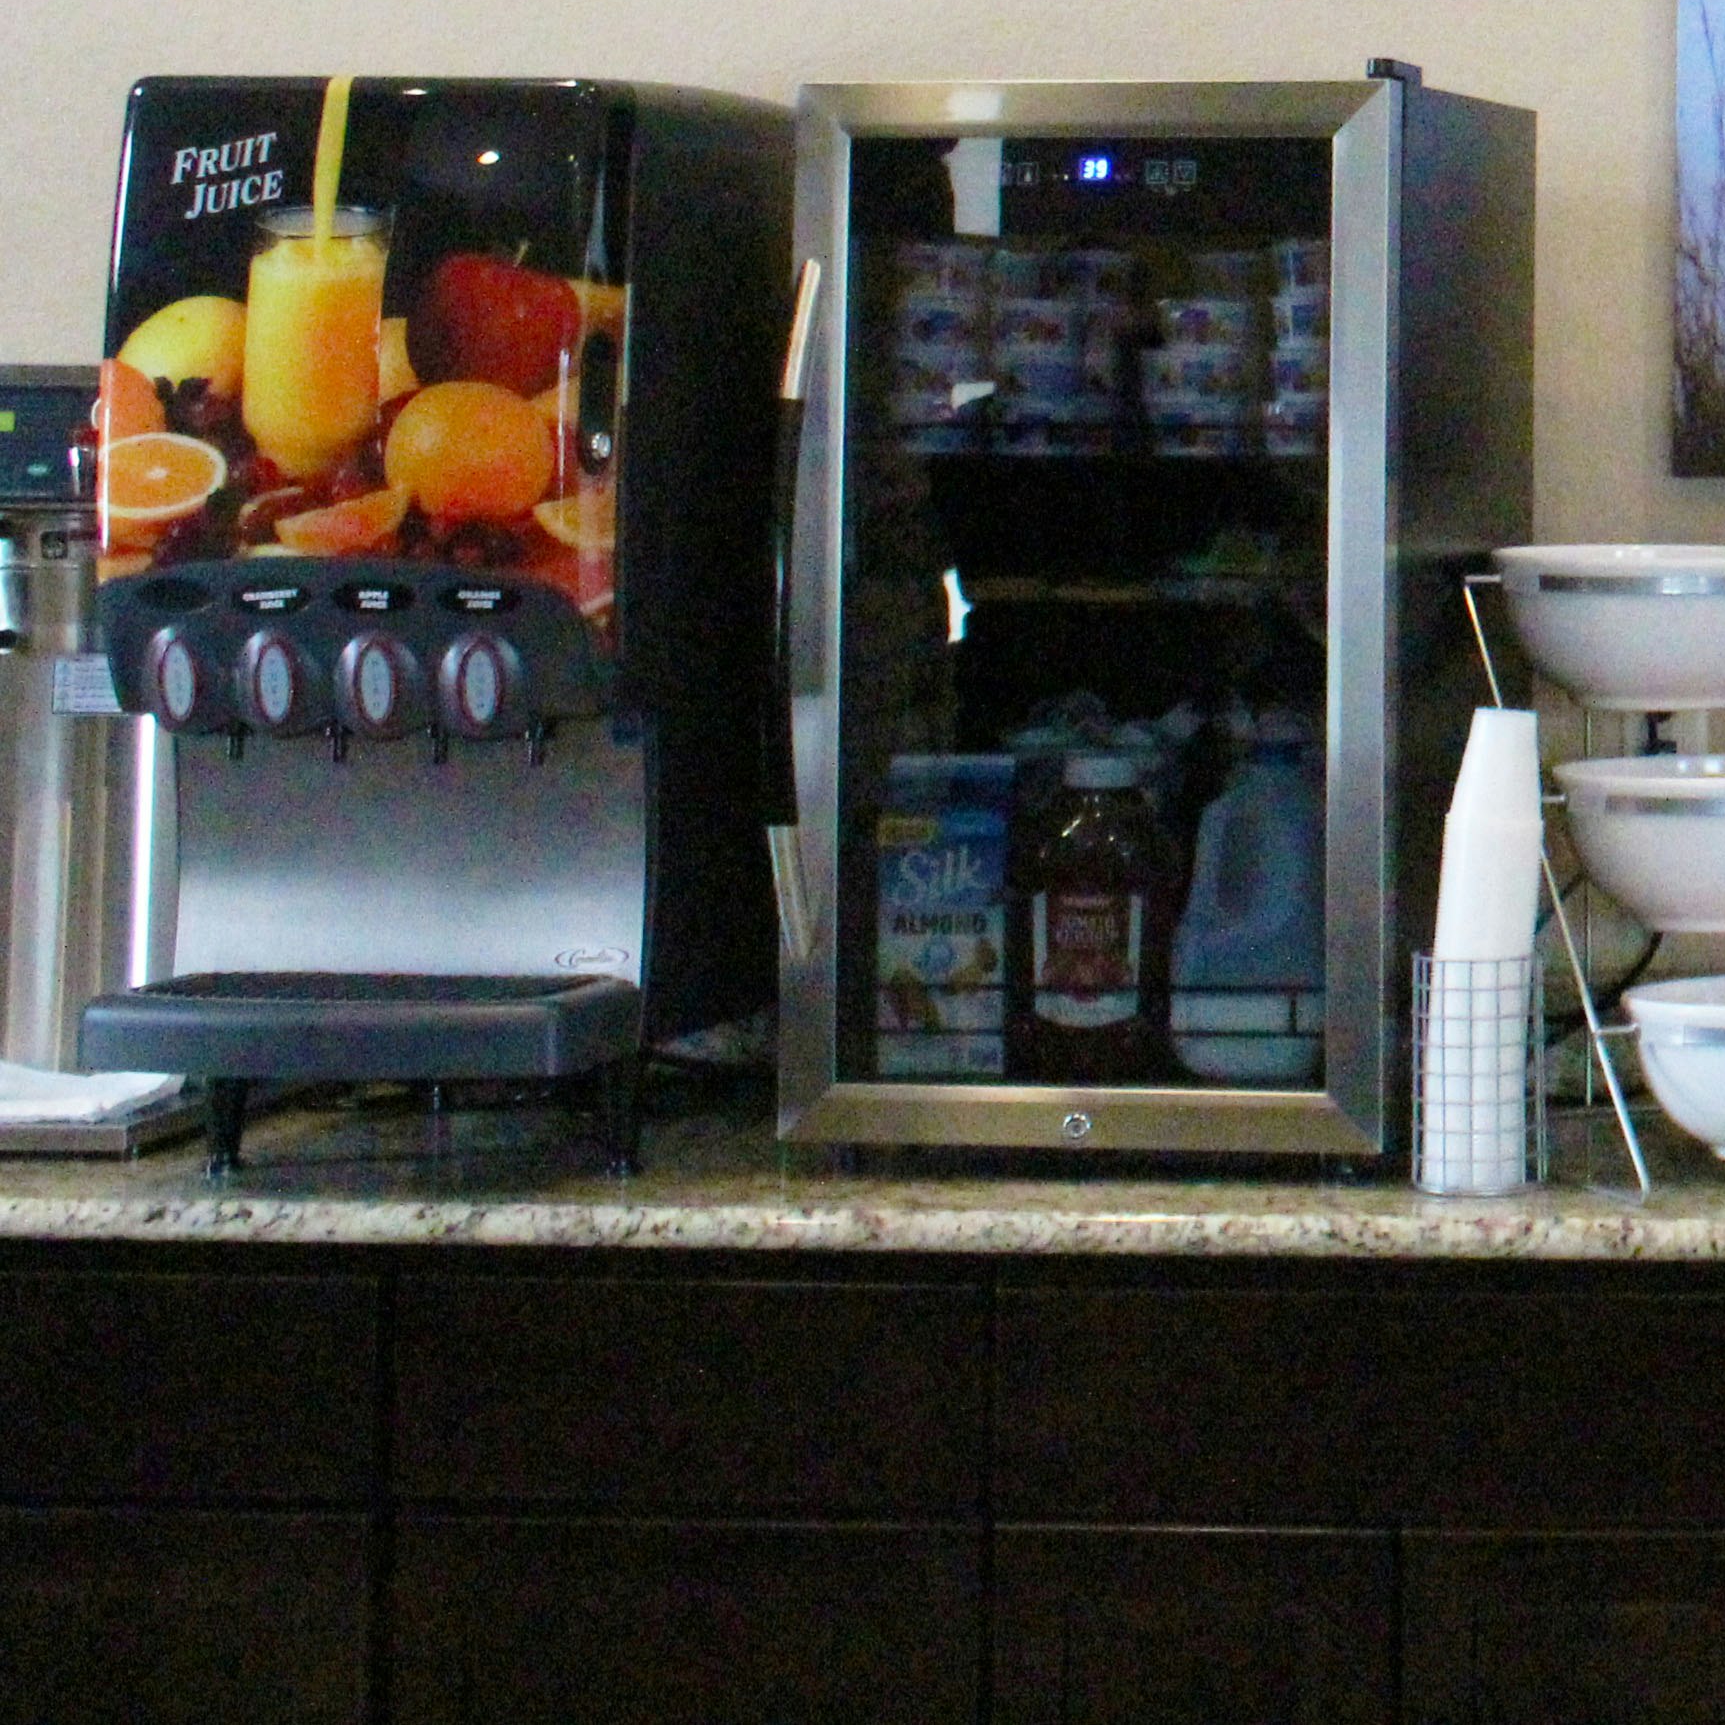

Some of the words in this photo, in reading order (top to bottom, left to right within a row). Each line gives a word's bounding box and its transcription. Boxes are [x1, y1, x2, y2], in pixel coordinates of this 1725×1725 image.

[170, 132, 277, 185] FRUIT
[1082, 158, 1109, 180] 39
[184, 170, 283, 220] JUICE
